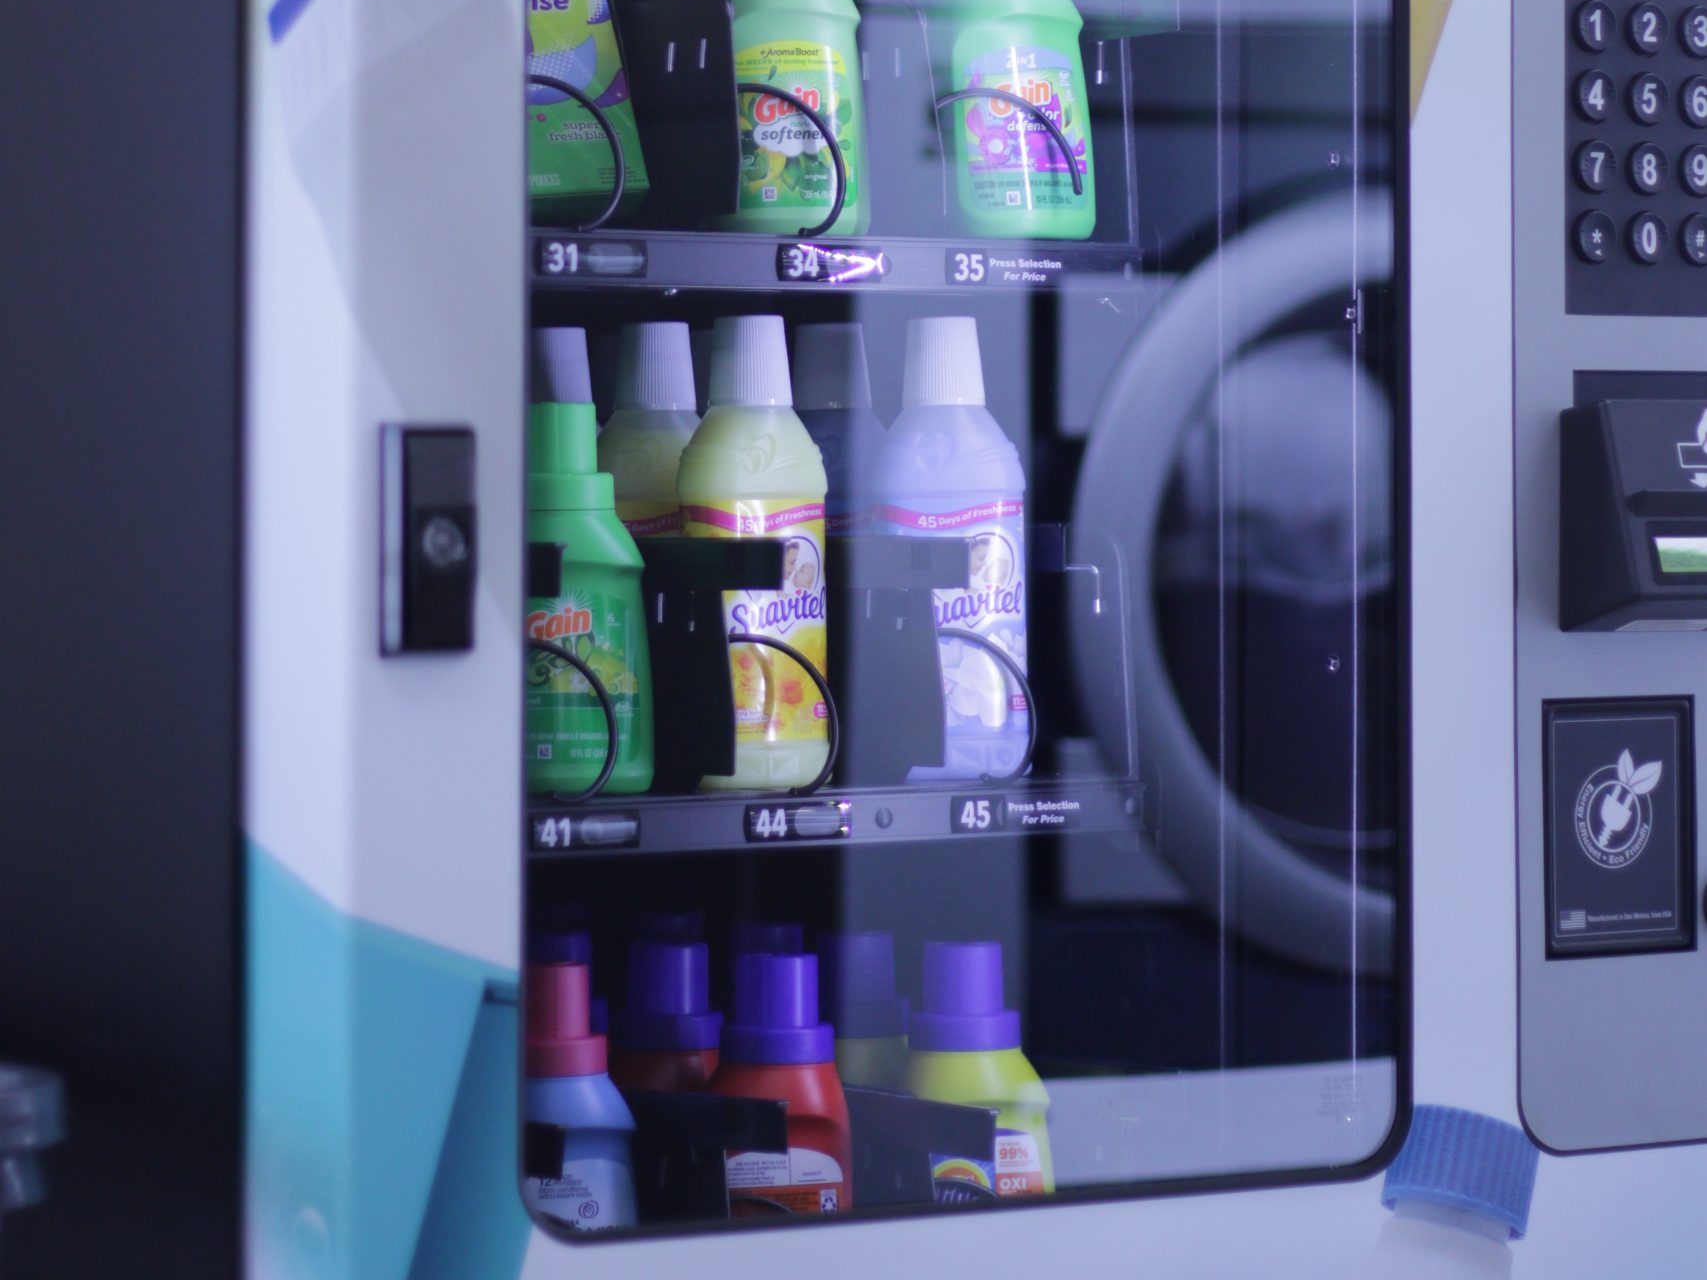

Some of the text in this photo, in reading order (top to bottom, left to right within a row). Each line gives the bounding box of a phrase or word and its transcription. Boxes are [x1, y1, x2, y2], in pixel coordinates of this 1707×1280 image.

[1589, 9, 1707, 47] 1 2 3
[1588, 78, 1707, 118] 4 5 6
[549, 132, 584, 141] fresh
[563, 121, 600, 131] super
[1007, 120, 1047, 132] defens
[1590, 151, 1707, 187] 7 8 9
[1641, 222, 1658, 255] 0
[547, 242, 579, 273] 31
[788, 248, 820, 277] 34
[954, 253, 1062, 282] 35 Press Selection
[1004, 271, 1047, 282] For Price
[784, 507, 822, 521] Freshness
[918, 504, 1017, 529] 45 Days of Freshness
[527, 607, 591, 640] Gain
[730, 585, 826, 634] Suavitel
[756, 807, 788, 838] 44
[961, 800, 1080, 829] 45 Press Selection
[1022, 814, 1065, 825] For Price
[1576, 783, 1650, 865] Energy Efficient Eco Friendly
[540, 817, 572, 848] 41
[999, 1147, 1029, 1160] 99%
[1000, 1176, 1027, 1191] OXI
